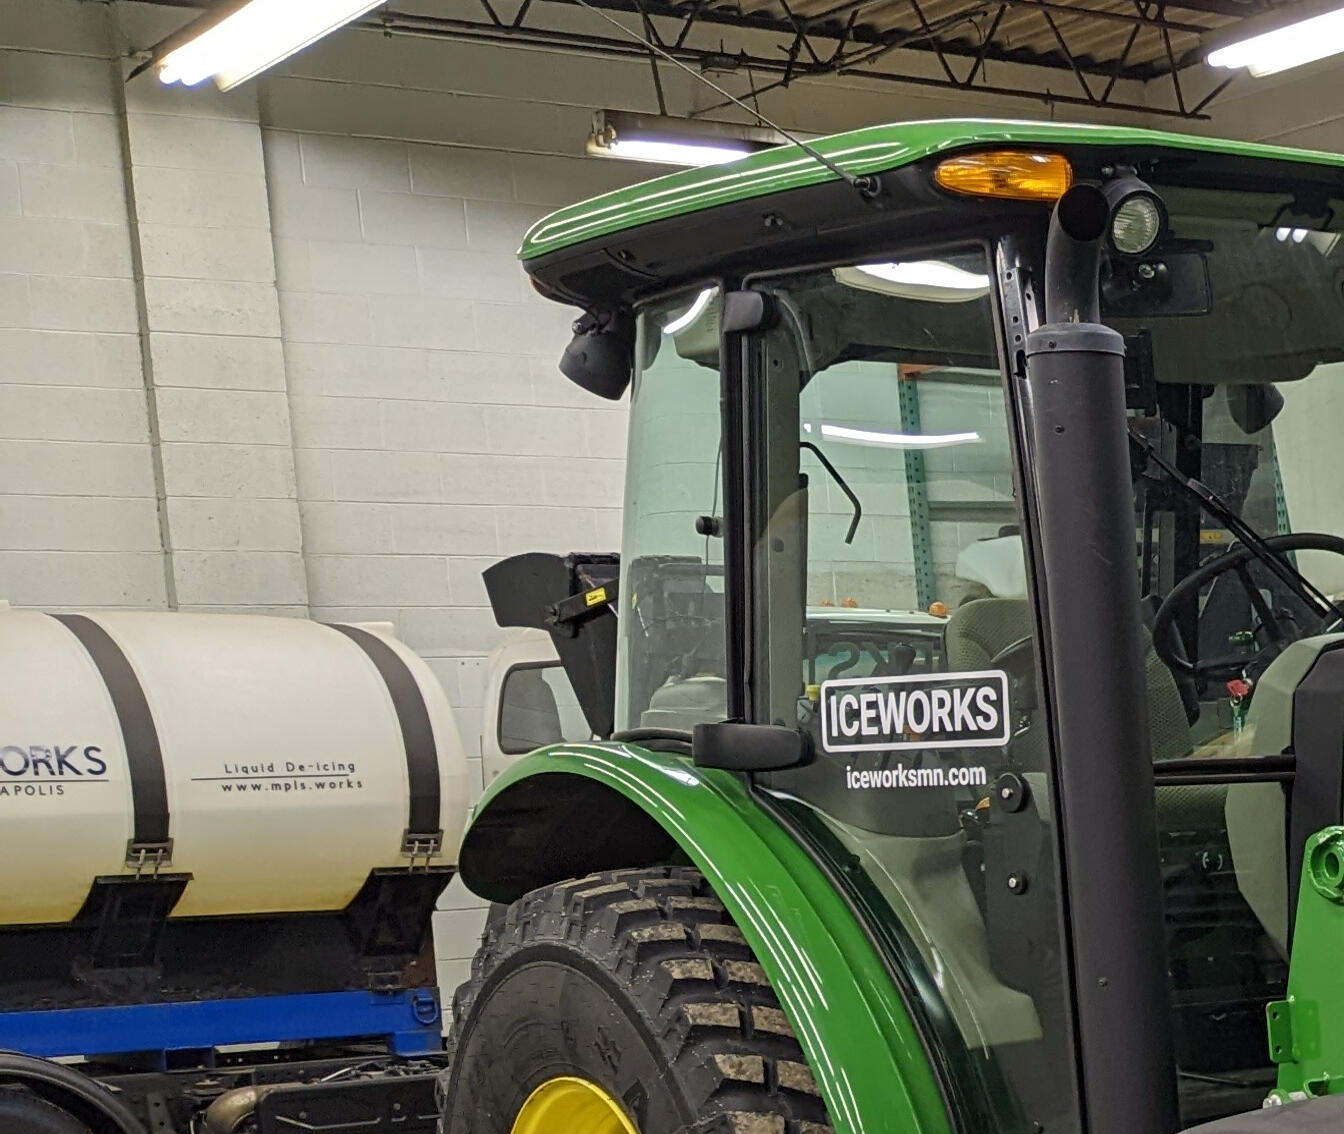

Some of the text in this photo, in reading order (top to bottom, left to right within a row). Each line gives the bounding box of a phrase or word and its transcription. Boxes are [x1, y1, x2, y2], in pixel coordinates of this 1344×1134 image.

[830, 686, 998, 737] ICEWORKS
[224, 761, 356, 775] Liquid De-icing
[846, 763, 987, 789] iceworksmn.com
[221, 778, 364, 792] www.mpls.works
